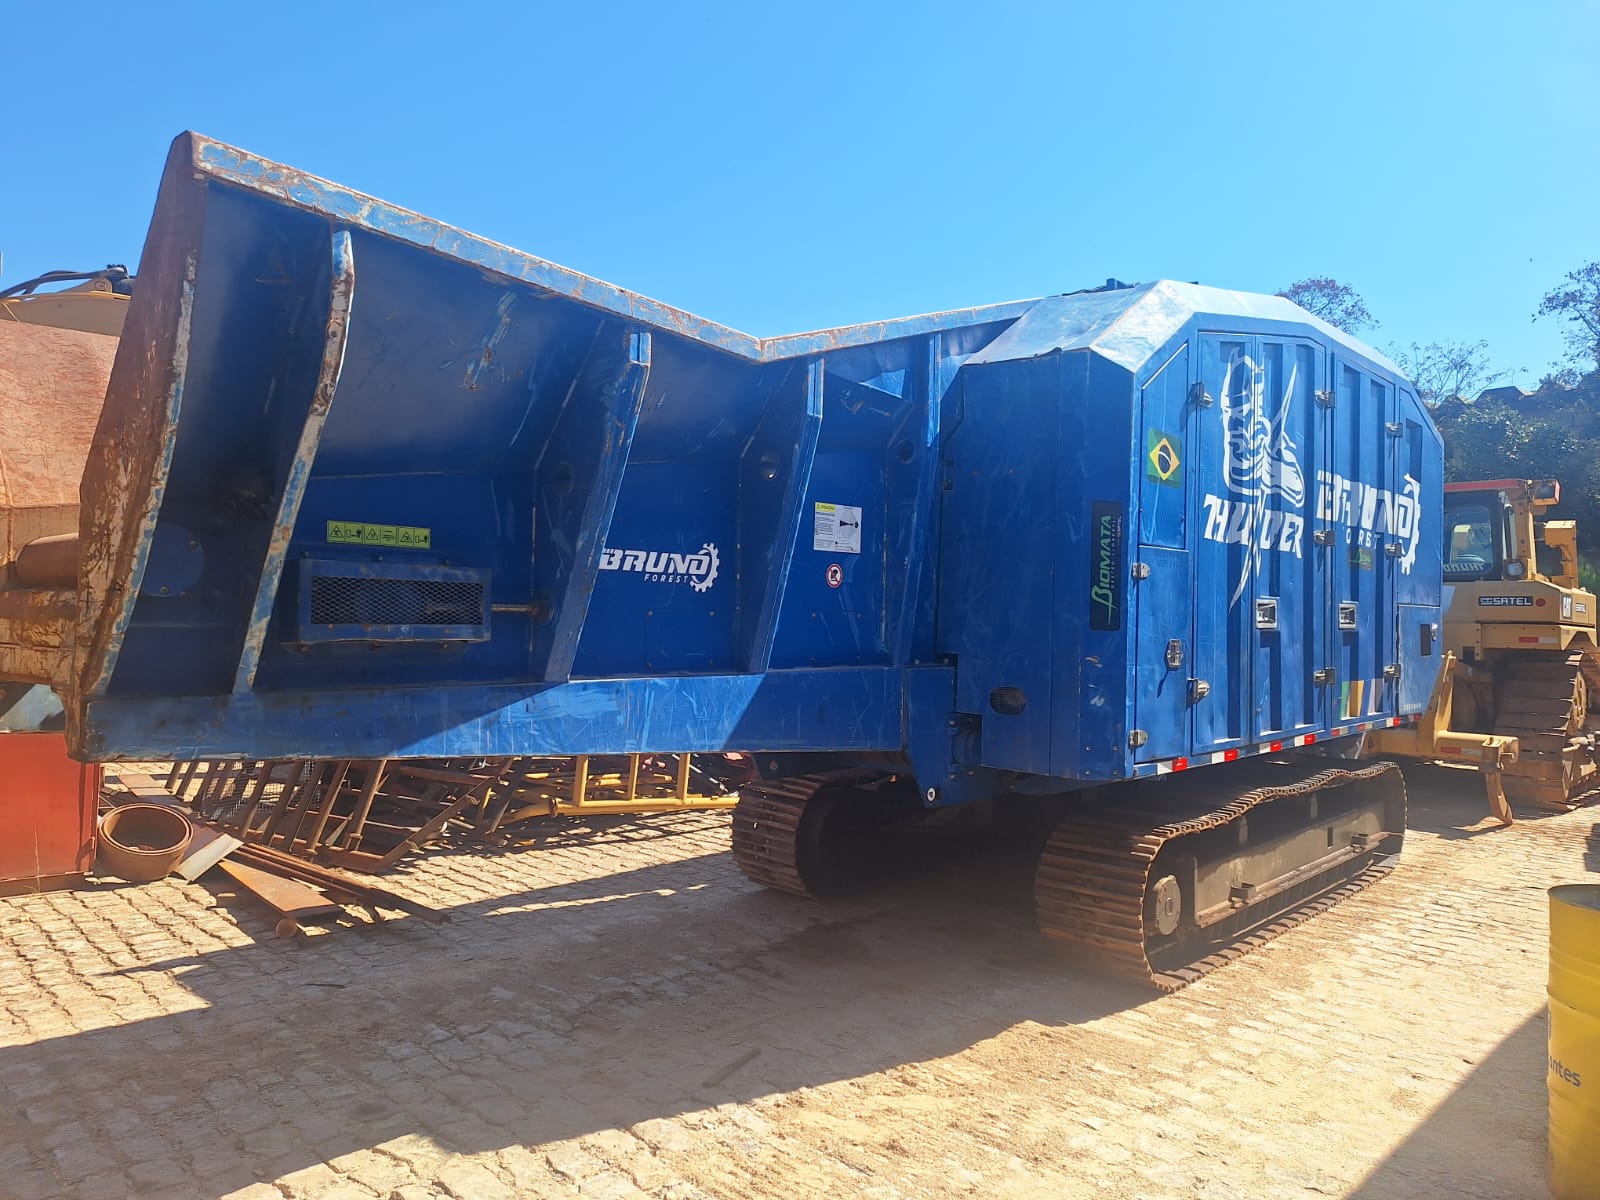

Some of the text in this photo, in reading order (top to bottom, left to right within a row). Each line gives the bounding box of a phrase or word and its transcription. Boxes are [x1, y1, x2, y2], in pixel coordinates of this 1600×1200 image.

[599, 548, 711, 575] BRUNO
[1091, 515, 1116, 614] BIOMATA
[644, 573, 689, 584] FOREST
